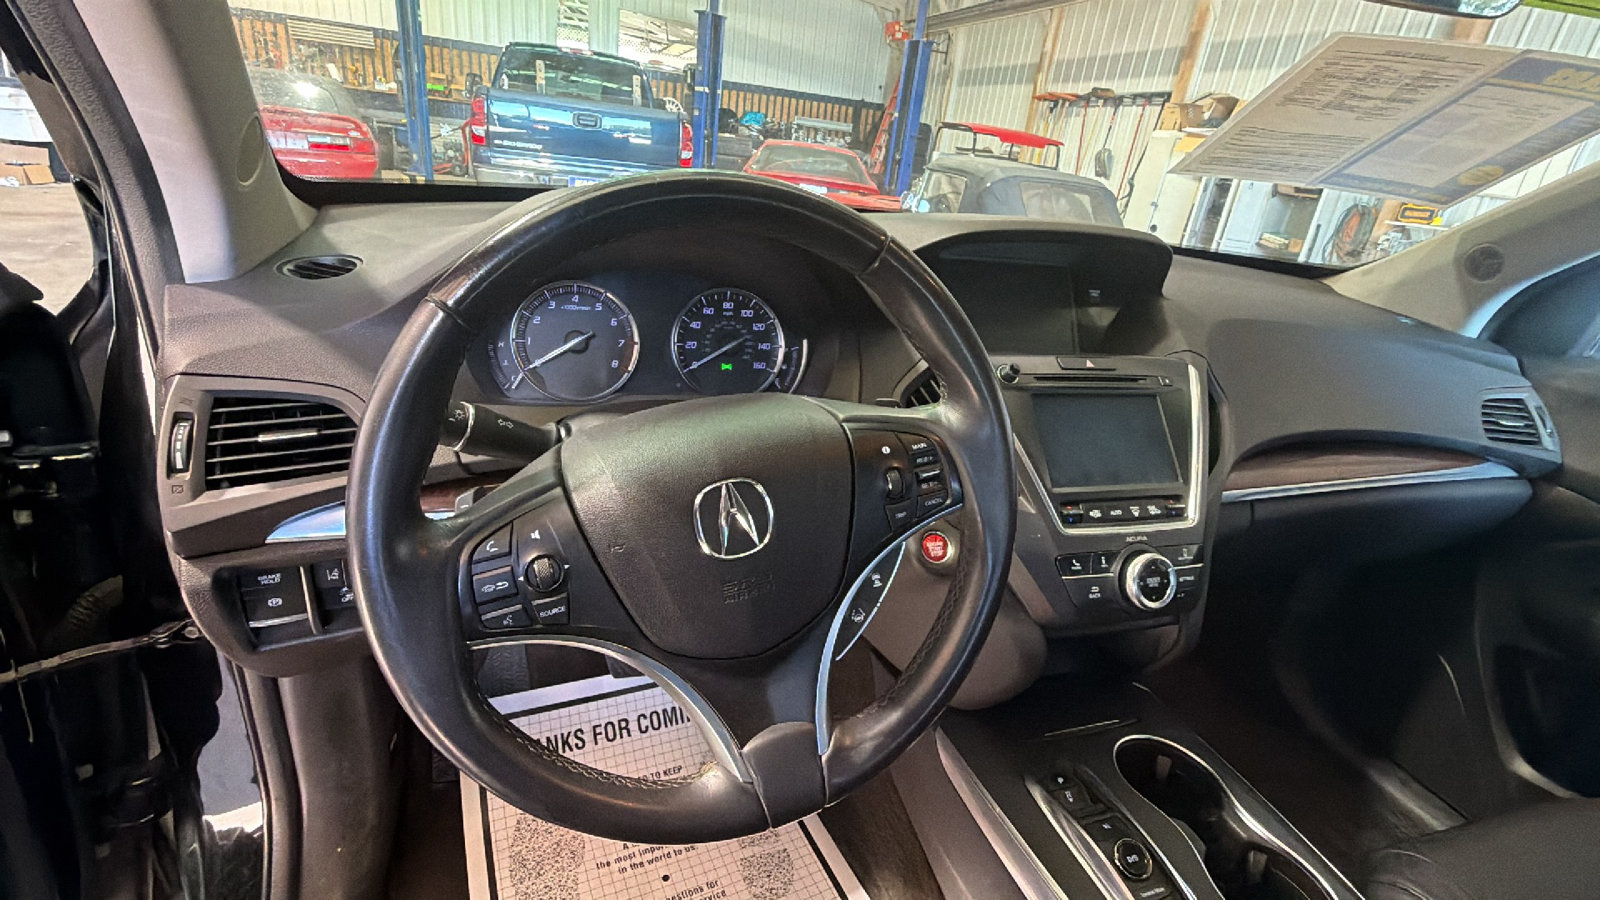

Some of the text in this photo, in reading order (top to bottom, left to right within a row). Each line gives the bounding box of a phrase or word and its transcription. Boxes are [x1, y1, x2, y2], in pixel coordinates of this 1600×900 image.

[548, 301, 556, 309] 3
[595, 303, 602, 311] 5
[703, 307, 714, 315] 60
[740, 309, 754, 318] 100
[533, 316, 541, 324] 2
[610, 318, 618, 327] 6
[690, 321, 701, 329] 40
[752, 323, 766, 331] 120
[618, 340, 625, 348] 7
[685, 341, 697, 349] 20
[758, 342, 771, 350] 140
[611, 360, 619, 368] 8
[753, 362, 767, 370] 160
[258, 573, 281, 581] BRAKE
[540, 606, 566, 618] SOURCE
[592, 718, 632, 746] FOR
[637, 706, 690, 734] COMI
[663, 765, 683, 777] KEEP
[596, 861, 611, 870] the
[614, 852, 636, 864] most
[618, 865, 628, 874] in
[630, 861, 645, 870] the
[647, 851, 672, 865] world
[706, 880, 719, 890] for
